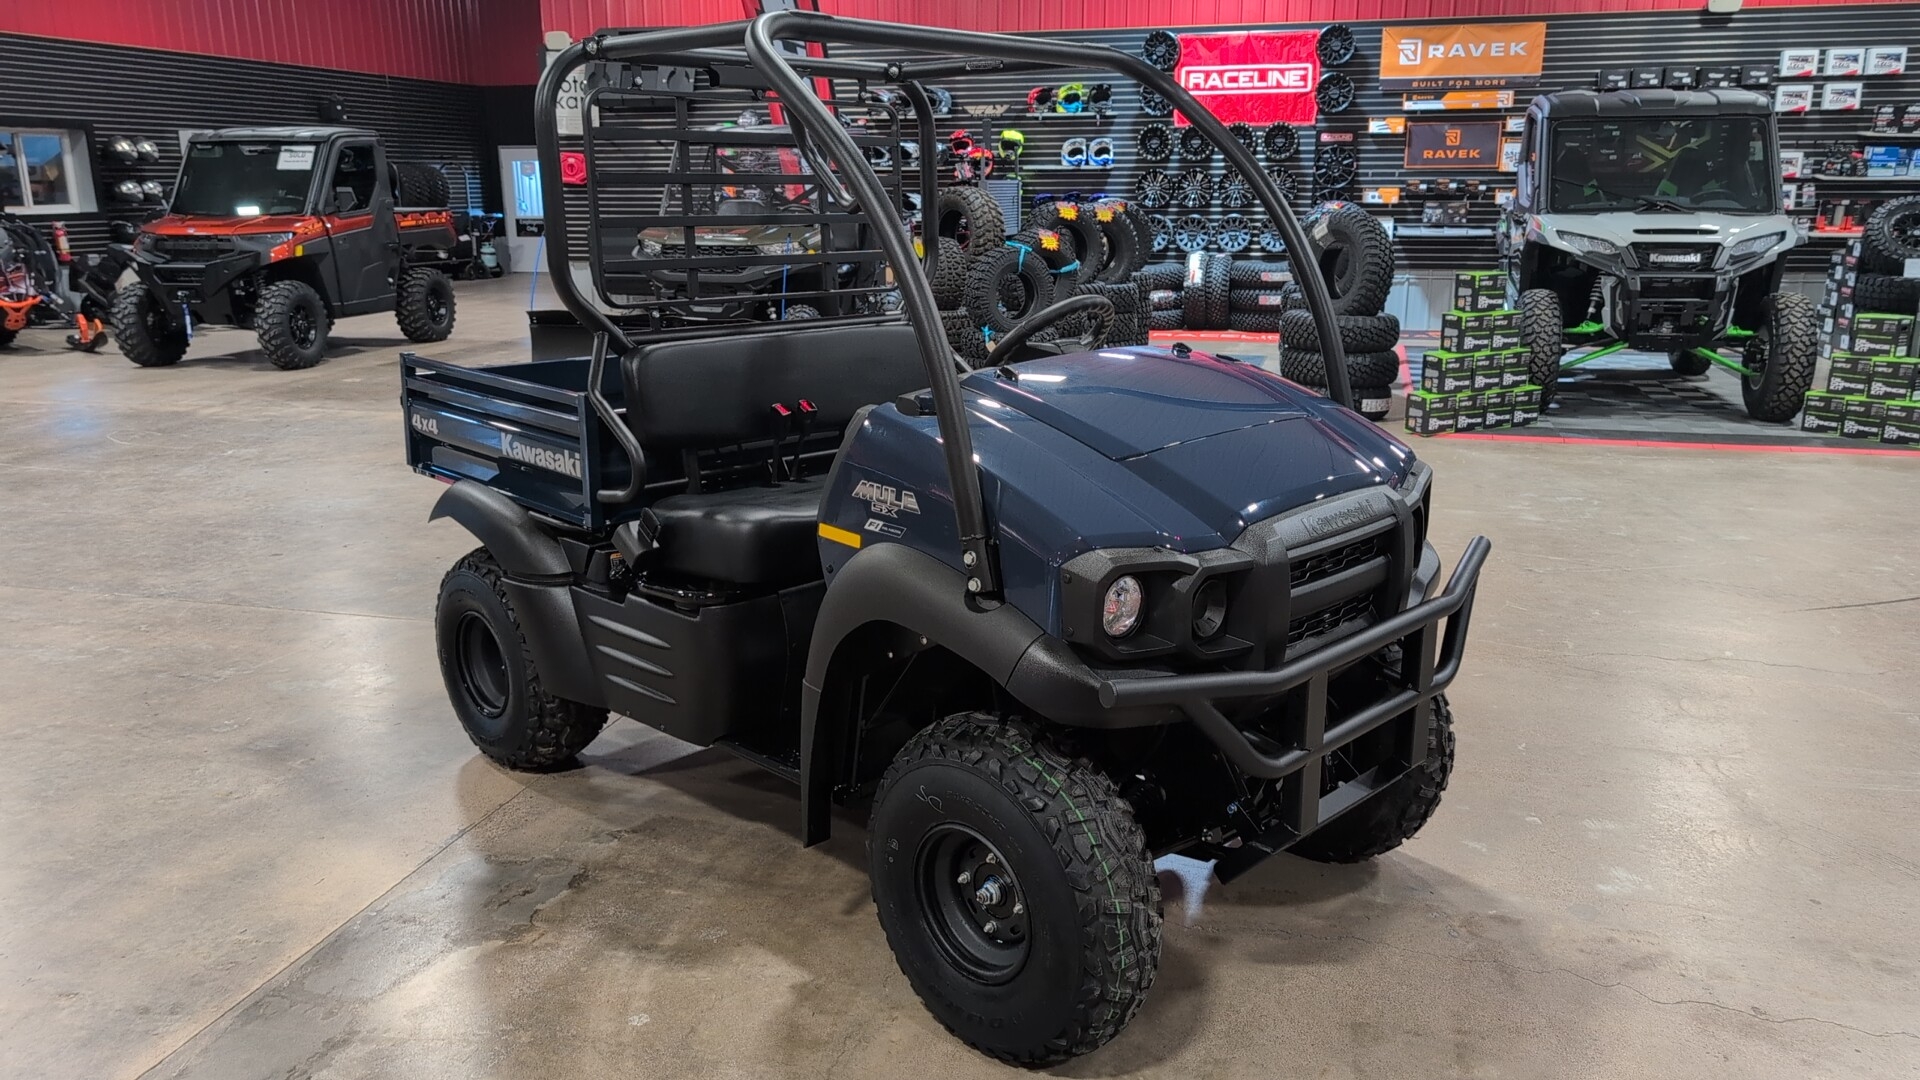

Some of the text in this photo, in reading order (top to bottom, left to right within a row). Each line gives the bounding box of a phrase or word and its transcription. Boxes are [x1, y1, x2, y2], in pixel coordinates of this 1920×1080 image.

[1427, 41, 1528, 59] RAVEK
[1189, 70, 1308, 89] RACELINE
[1411, 78, 1506, 88] BUILT FOR MORE
[1423, 149, 1481, 159] RAVEK
[1649, 252, 1701, 263] Kawasaki
[412, 413, 439, 435] 4x4
[500, 431, 582, 478] Kawasaki
[852, 479, 921, 515] MULE
[871, 501, 898, 518] SX
[1301, 499, 1375, 537] Kawasaki
